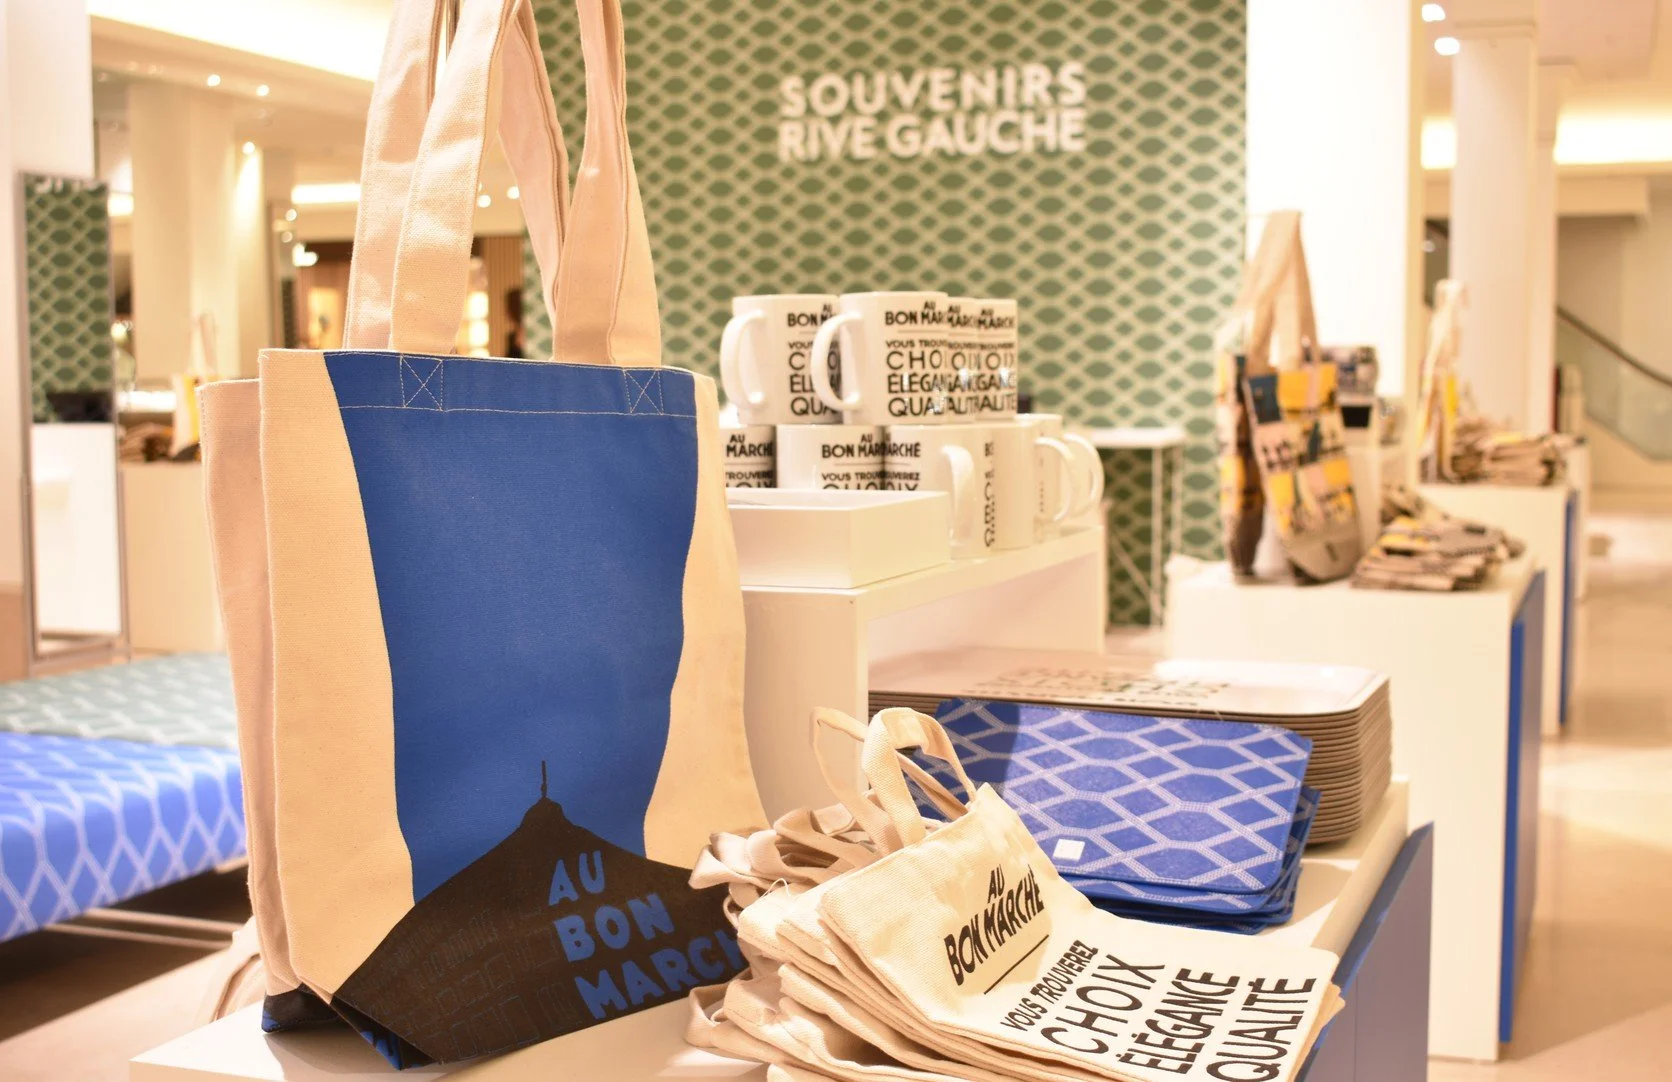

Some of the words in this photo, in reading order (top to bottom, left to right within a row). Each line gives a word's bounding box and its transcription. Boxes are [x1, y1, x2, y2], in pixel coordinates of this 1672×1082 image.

[779, 61, 1087, 118] SOUVENIRS
[778, 116, 878, 163] RIVE
[886, 108, 1087, 158] GAUCHE
[788, 313, 818, 327] BON
[885, 311, 917, 326] BON
[886, 340, 915, 349] VOUS
[730, 434, 746, 444] AU
[822, 444, 854, 458] BON
[861, 434, 873, 443] AU
[822, 473, 851, 482] VOUS
[548, 850, 606, 906] AU
[988, 864, 1005, 904] AU
[553, 893, 675, 963] BON
[944, 914, 989, 986] BON
[1000, 998, 1048, 1032] VOUS
[1030, 940, 1099, 1005] TROUVEREZ
[1040, 954, 1166, 1055] CHOIX
[1115, 968, 1241, 1075] ÉLÉGANCE
[1206, 978, 1317, 1082] QUALITÉ
